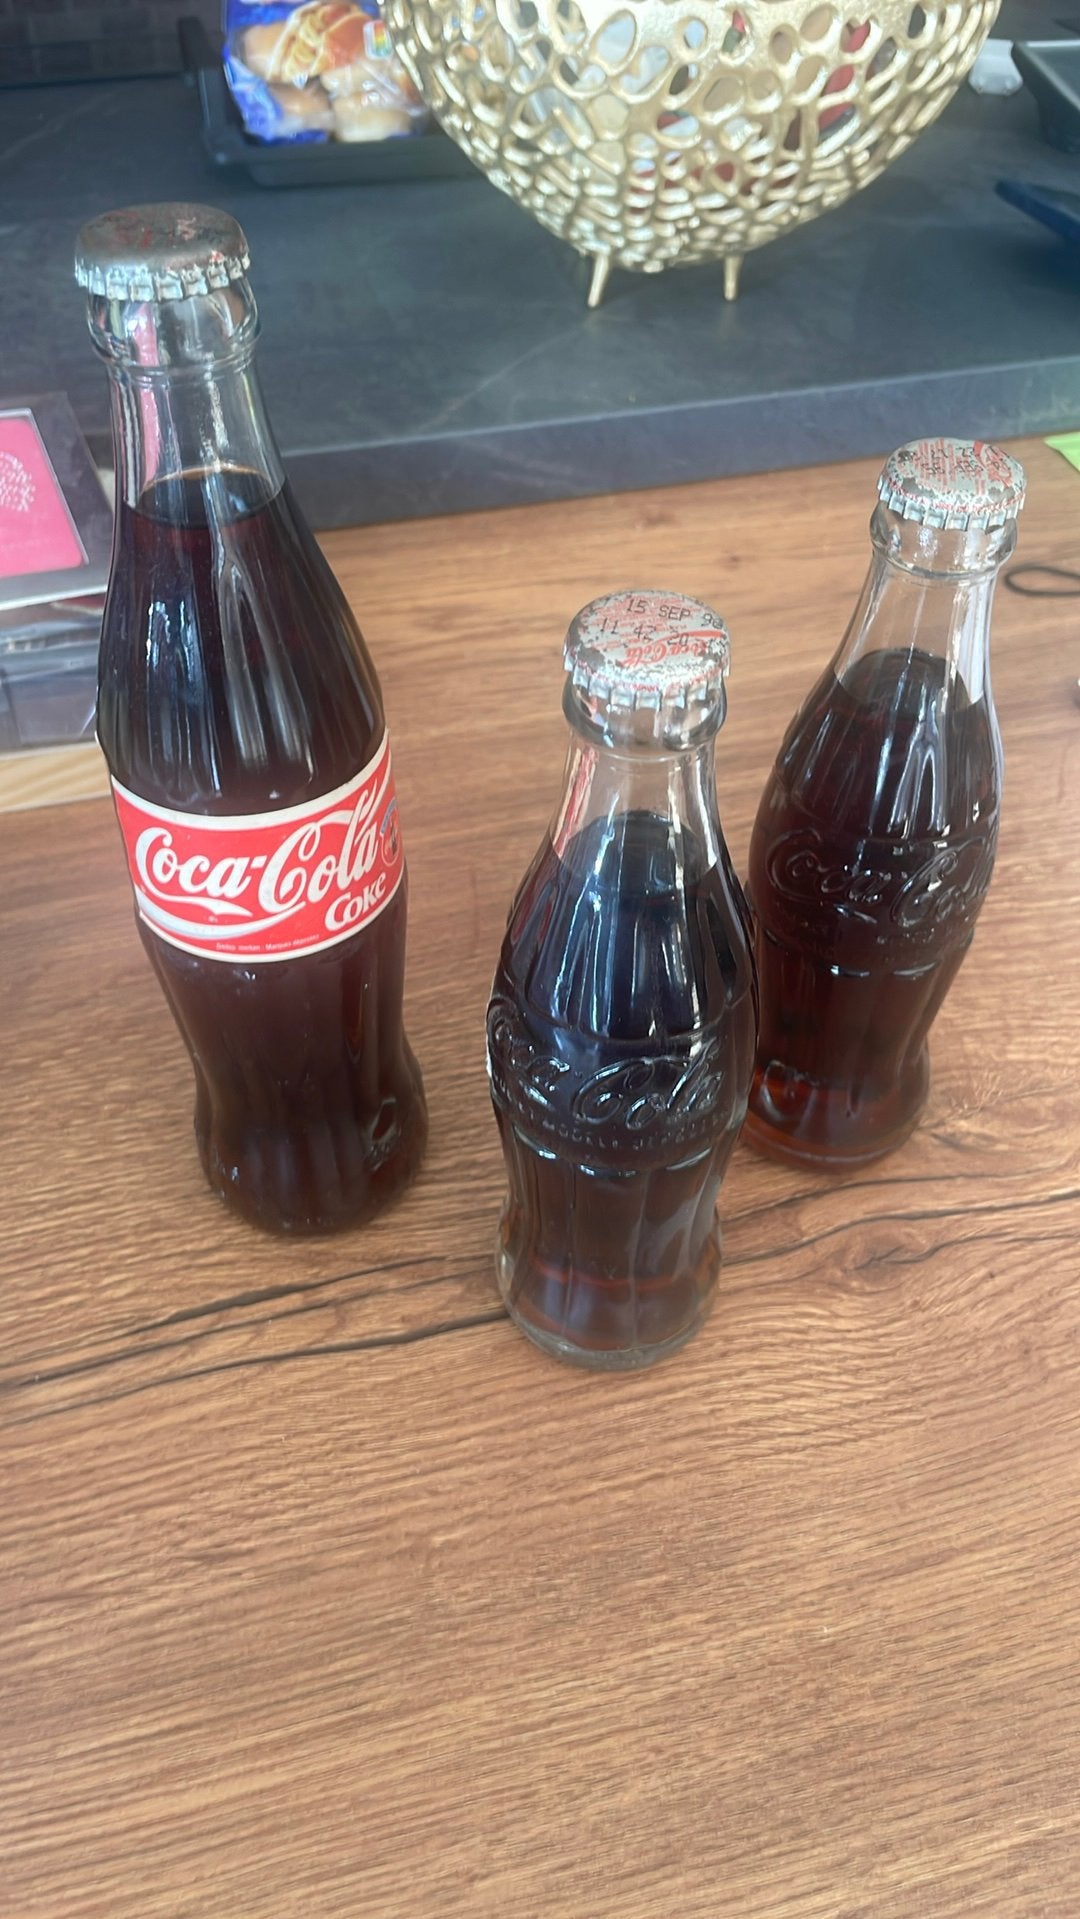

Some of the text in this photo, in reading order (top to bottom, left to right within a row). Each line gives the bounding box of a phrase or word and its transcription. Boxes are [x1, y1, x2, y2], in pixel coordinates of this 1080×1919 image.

[600, 617, 619, 635] 11
[627, 598, 648, 614] 15
[658, 604, 691, 621] SEP
[135, 780, 382, 917] Coca-Cola
[325, 872, 386, 931] Coke
